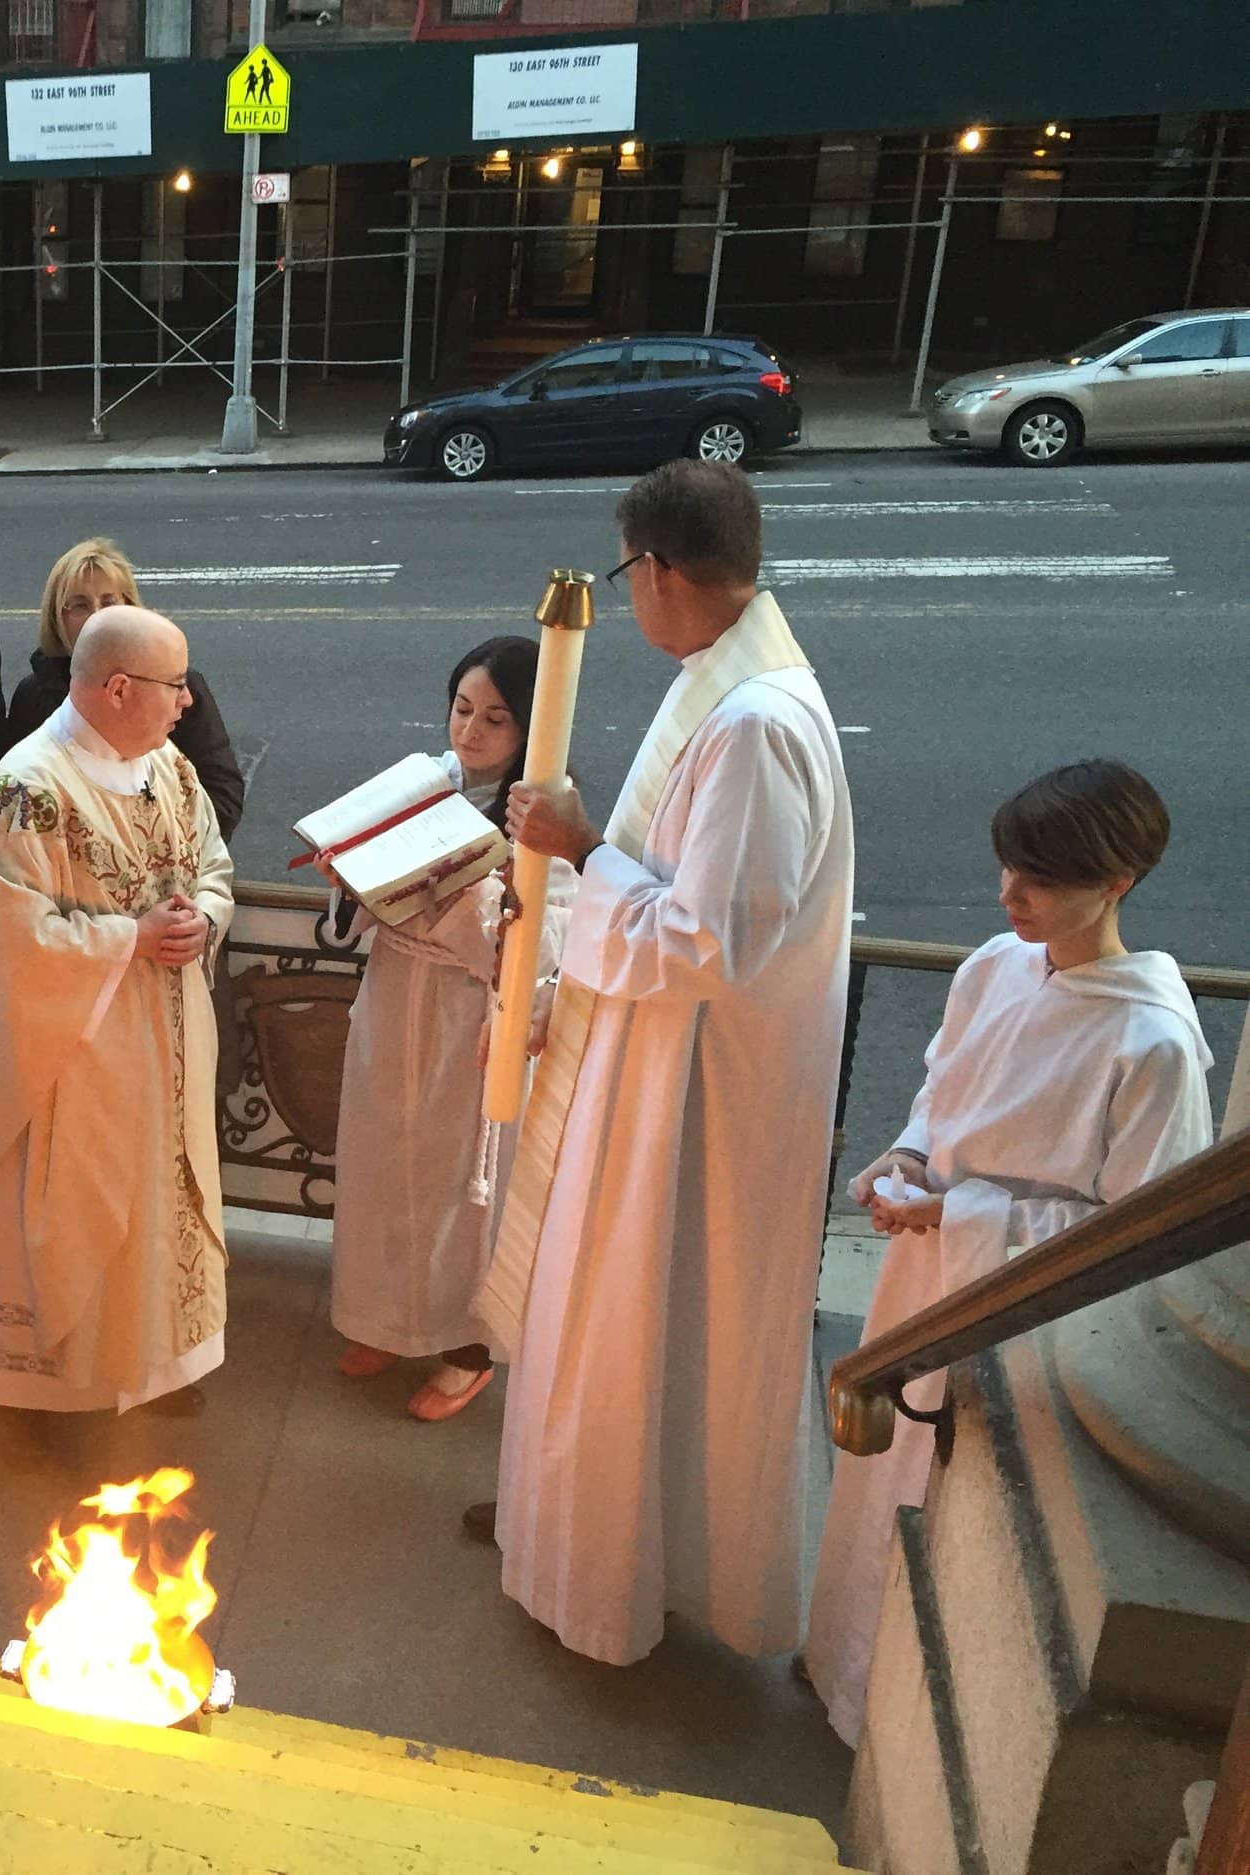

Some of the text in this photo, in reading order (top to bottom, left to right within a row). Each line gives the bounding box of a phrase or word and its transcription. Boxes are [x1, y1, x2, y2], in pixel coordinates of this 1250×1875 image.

[509, 55, 601, 73] 130 EAST 96TH STREET
[31, 84, 116, 100] 132 EAST 96TH STREET
[529, 96, 574, 108] MANAGEMENT
[233, 111, 281, 126] AHEAD
